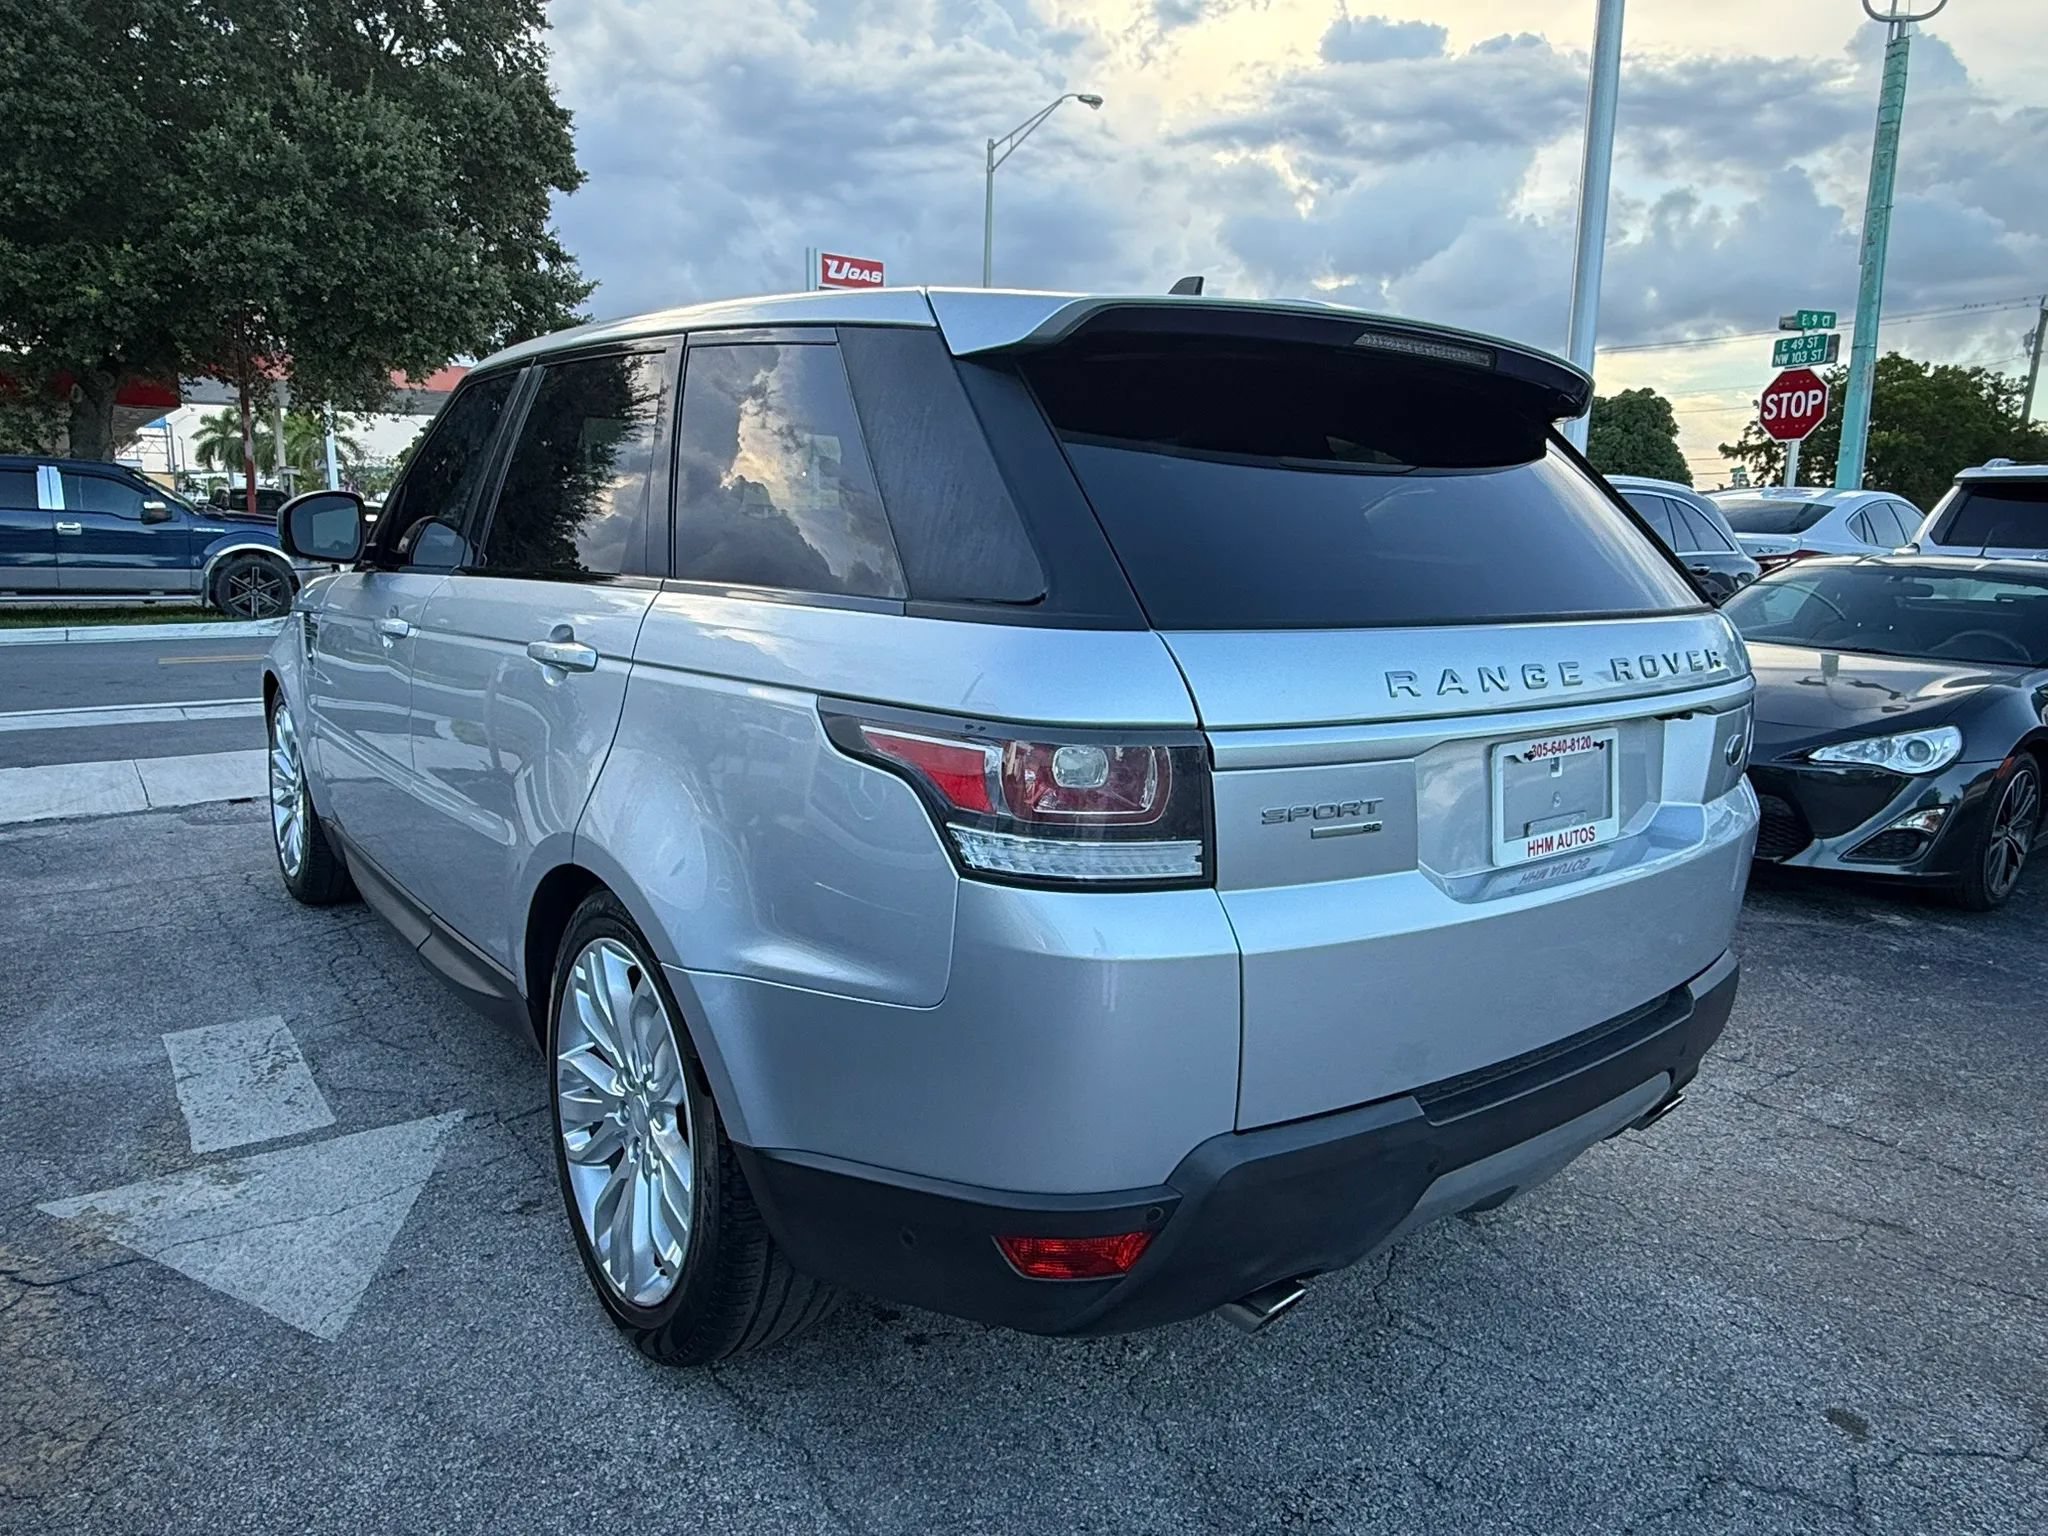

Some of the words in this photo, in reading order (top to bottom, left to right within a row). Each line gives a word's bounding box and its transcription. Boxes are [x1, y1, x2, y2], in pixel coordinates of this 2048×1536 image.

[1802, 314, 1808, 326] E
[1812, 314, 1818, 326] 9
[1782, 341, 1789, 352] E
[1791, 338, 1804, 350] 49
[1807, 336, 1819, 349] ST
[1775, 353, 1790, 365] NW
[1792, 351, 1808, 363] 103
[1810, 349, 1823, 361] ST
[1763, 389, 1823, 420] STOP
[1385, 661, 1583, 698] RANGE
[1610, 648, 1723, 682] ROVER
[1531, 735, 1592, 758] 305-640-8120
[1262, 797, 1384, 825] SPORT
[1527, 835, 1554, 858] HHM
[1556, 825, 1596, 850] AUTOS
